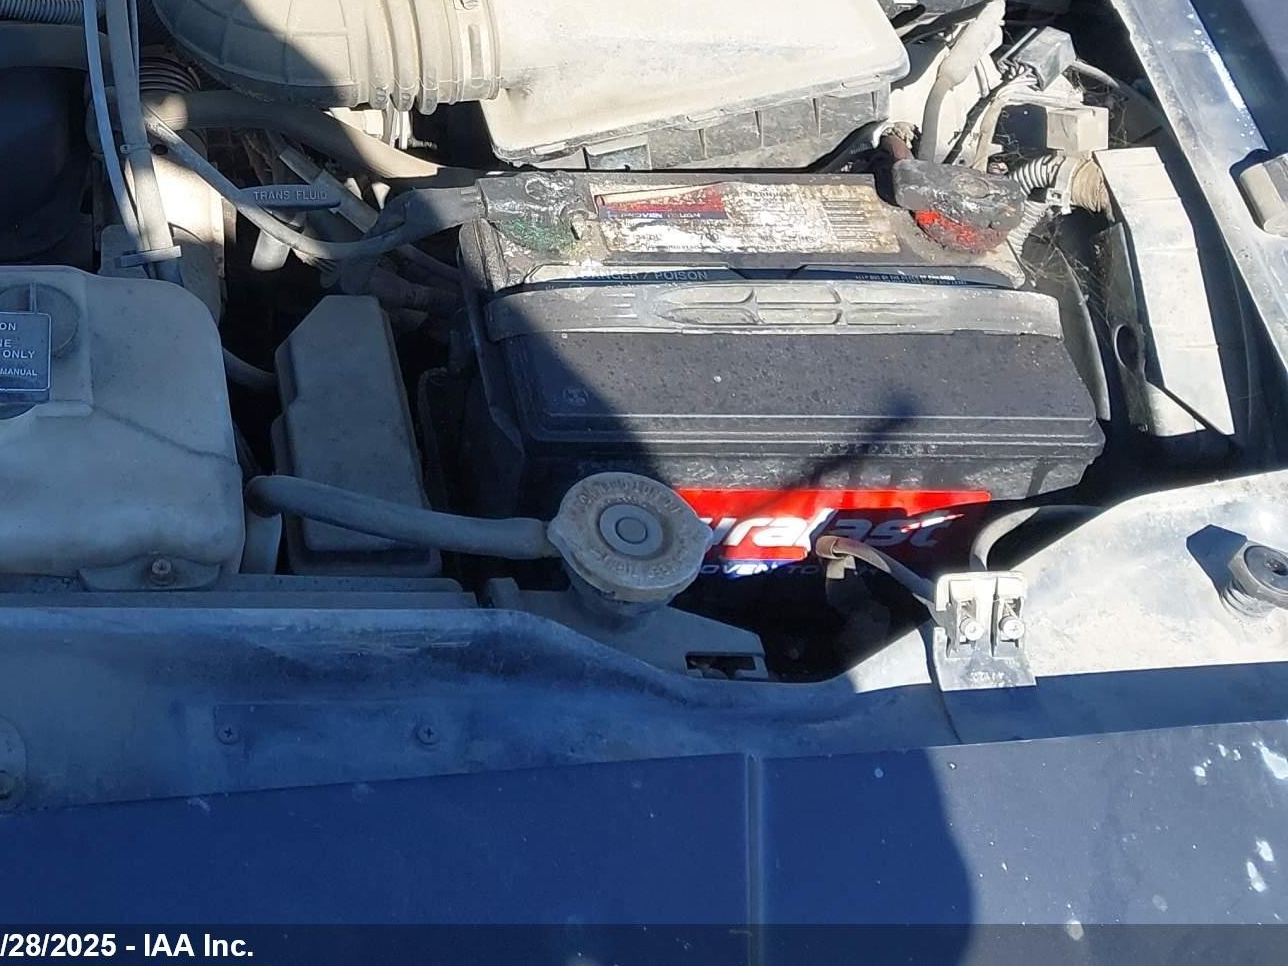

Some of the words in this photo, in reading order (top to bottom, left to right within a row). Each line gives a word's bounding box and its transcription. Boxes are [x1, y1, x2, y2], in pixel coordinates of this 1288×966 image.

[254, 190, 290, 201] TRANS
[295, 190, 327, 201] FLUID
[654, 270, 709, 281] POISON
[2, 349, 36, 359] ONLY
[0, 367, 38, 377] MANUAL
